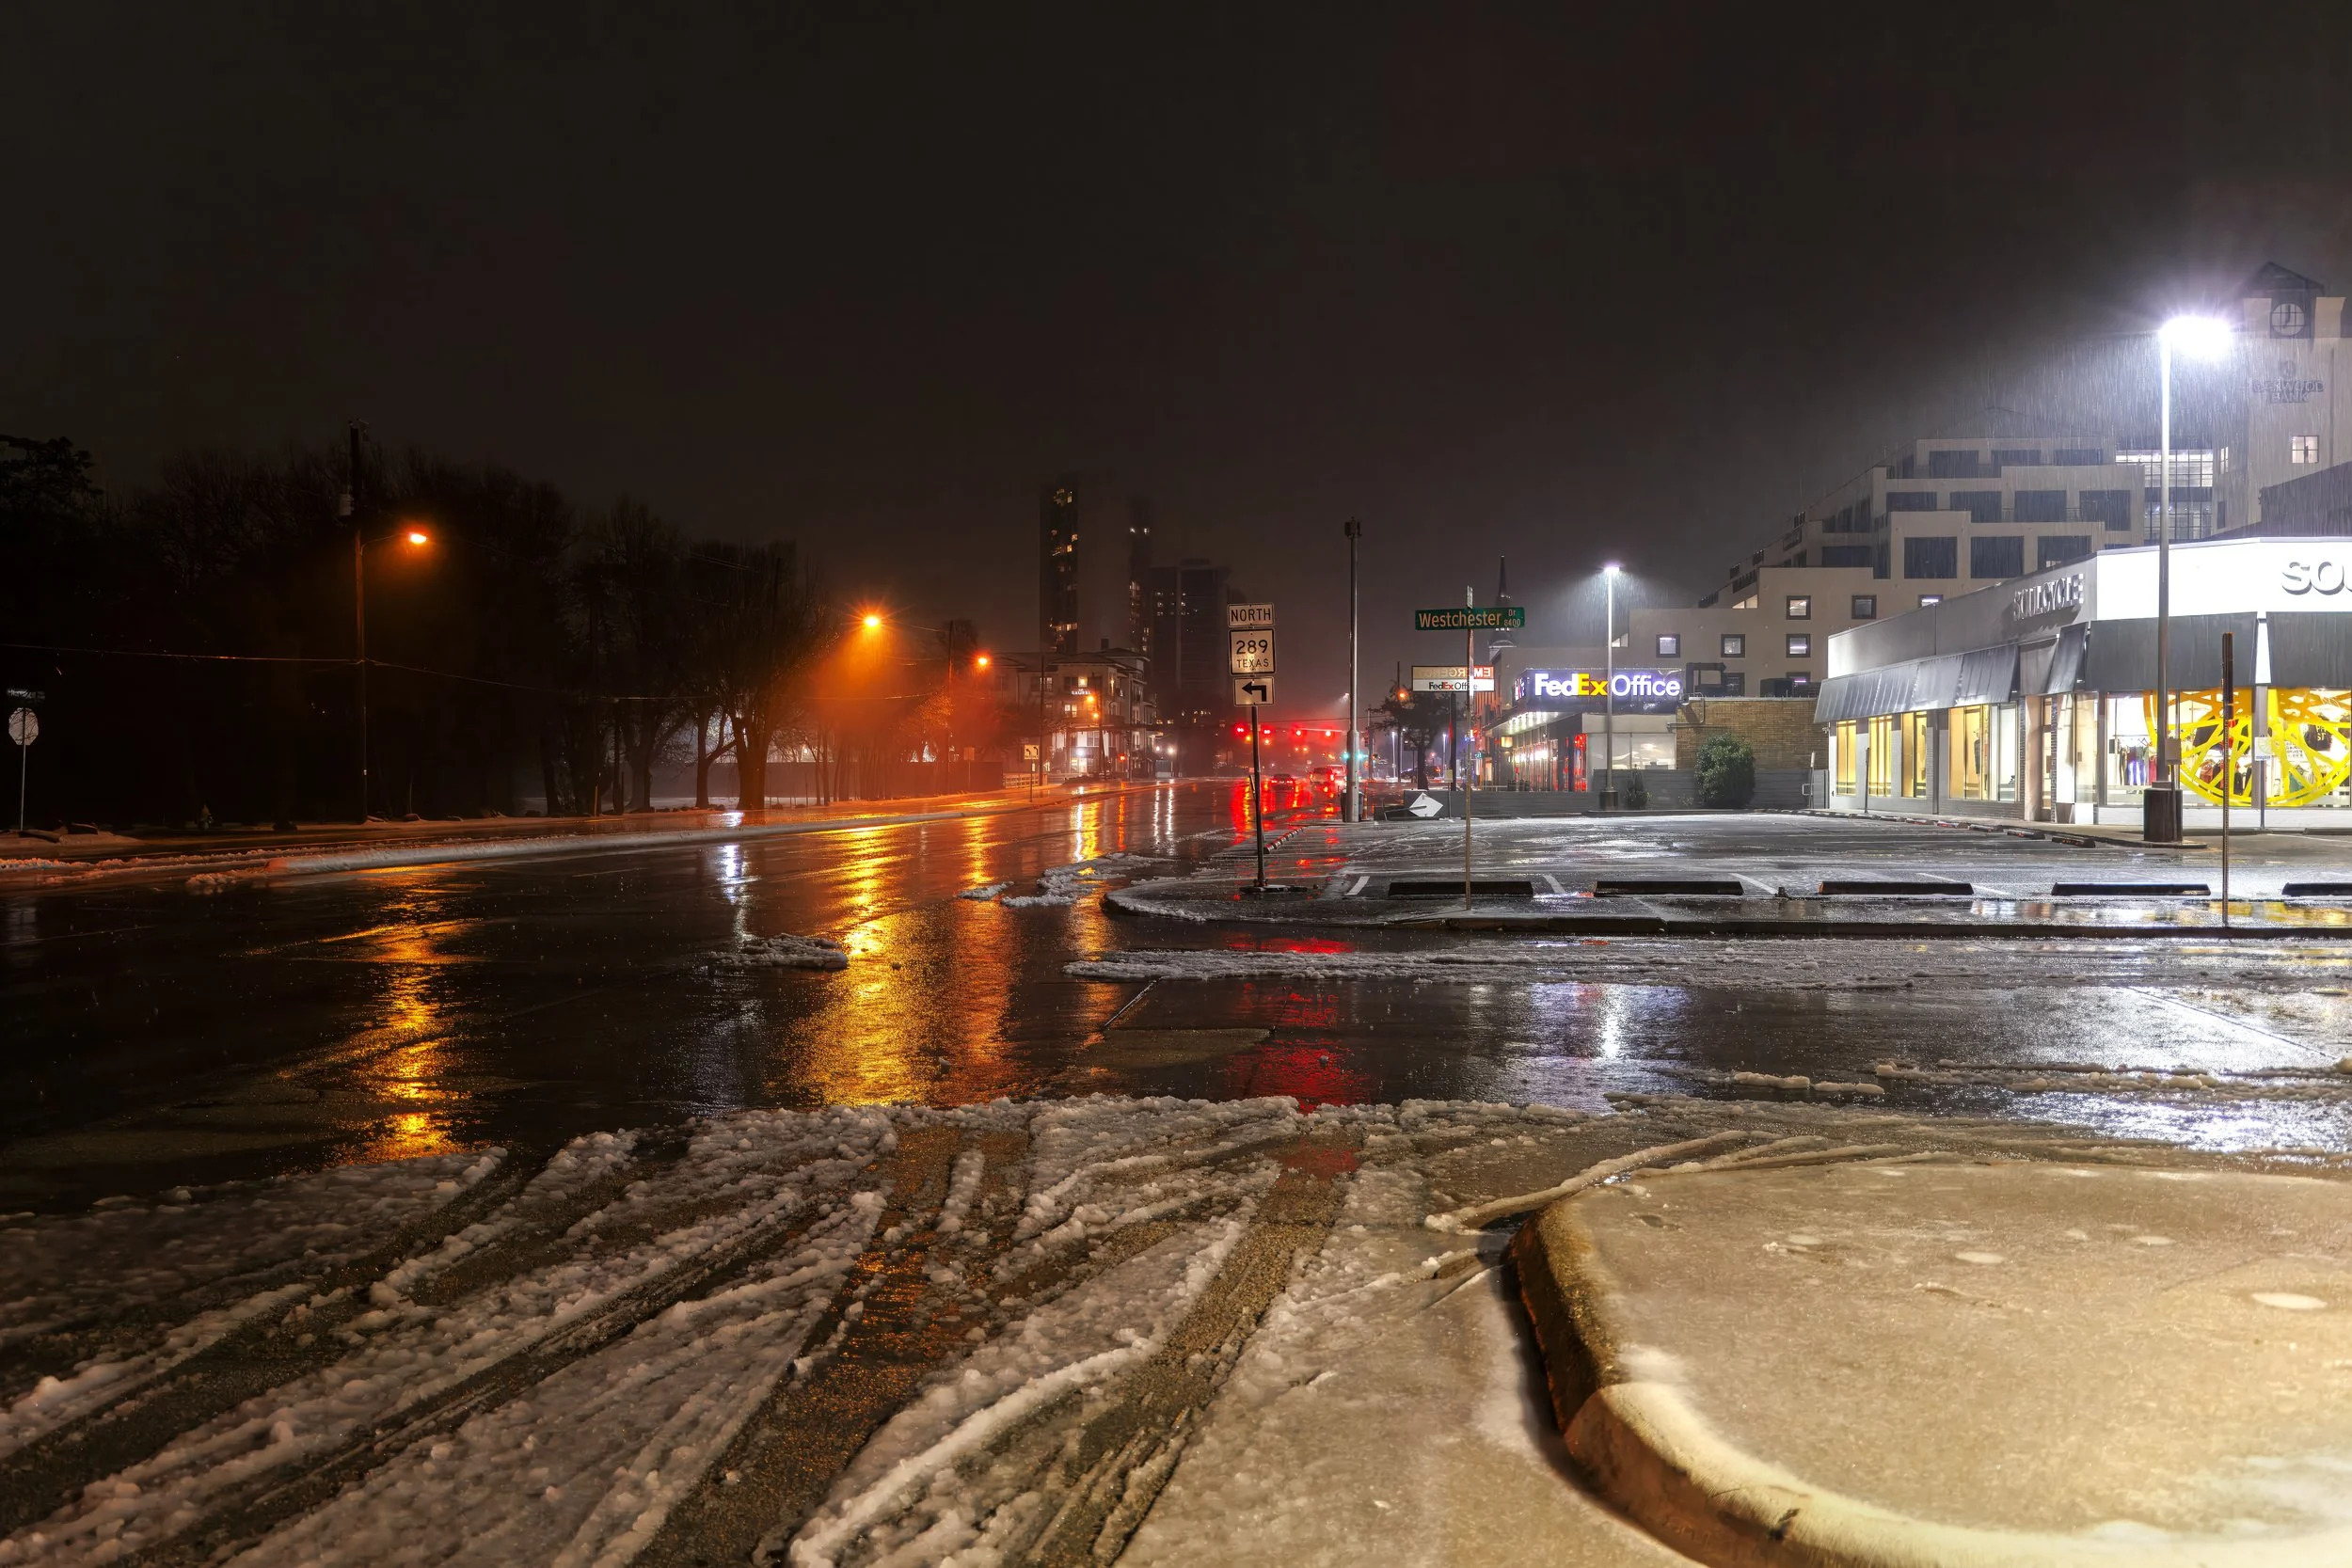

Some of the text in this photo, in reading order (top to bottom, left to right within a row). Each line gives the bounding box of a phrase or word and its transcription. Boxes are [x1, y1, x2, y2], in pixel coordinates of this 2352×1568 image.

[2280, 561, 2352, 595] SO
[1231, 609, 1271, 622] NORTH
[1419, 610, 1502, 628] Westchester
[1508, 609, 1516, 617] Dr
[1236, 640, 1268, 655] 289
[1237, 658, 1269, 668] TEXAS
[1428, 681, 1478, 690] FedEx Offe
[1534, 673, 1608, 696] FedEx
[1611, 674, 1681, 696] Office
